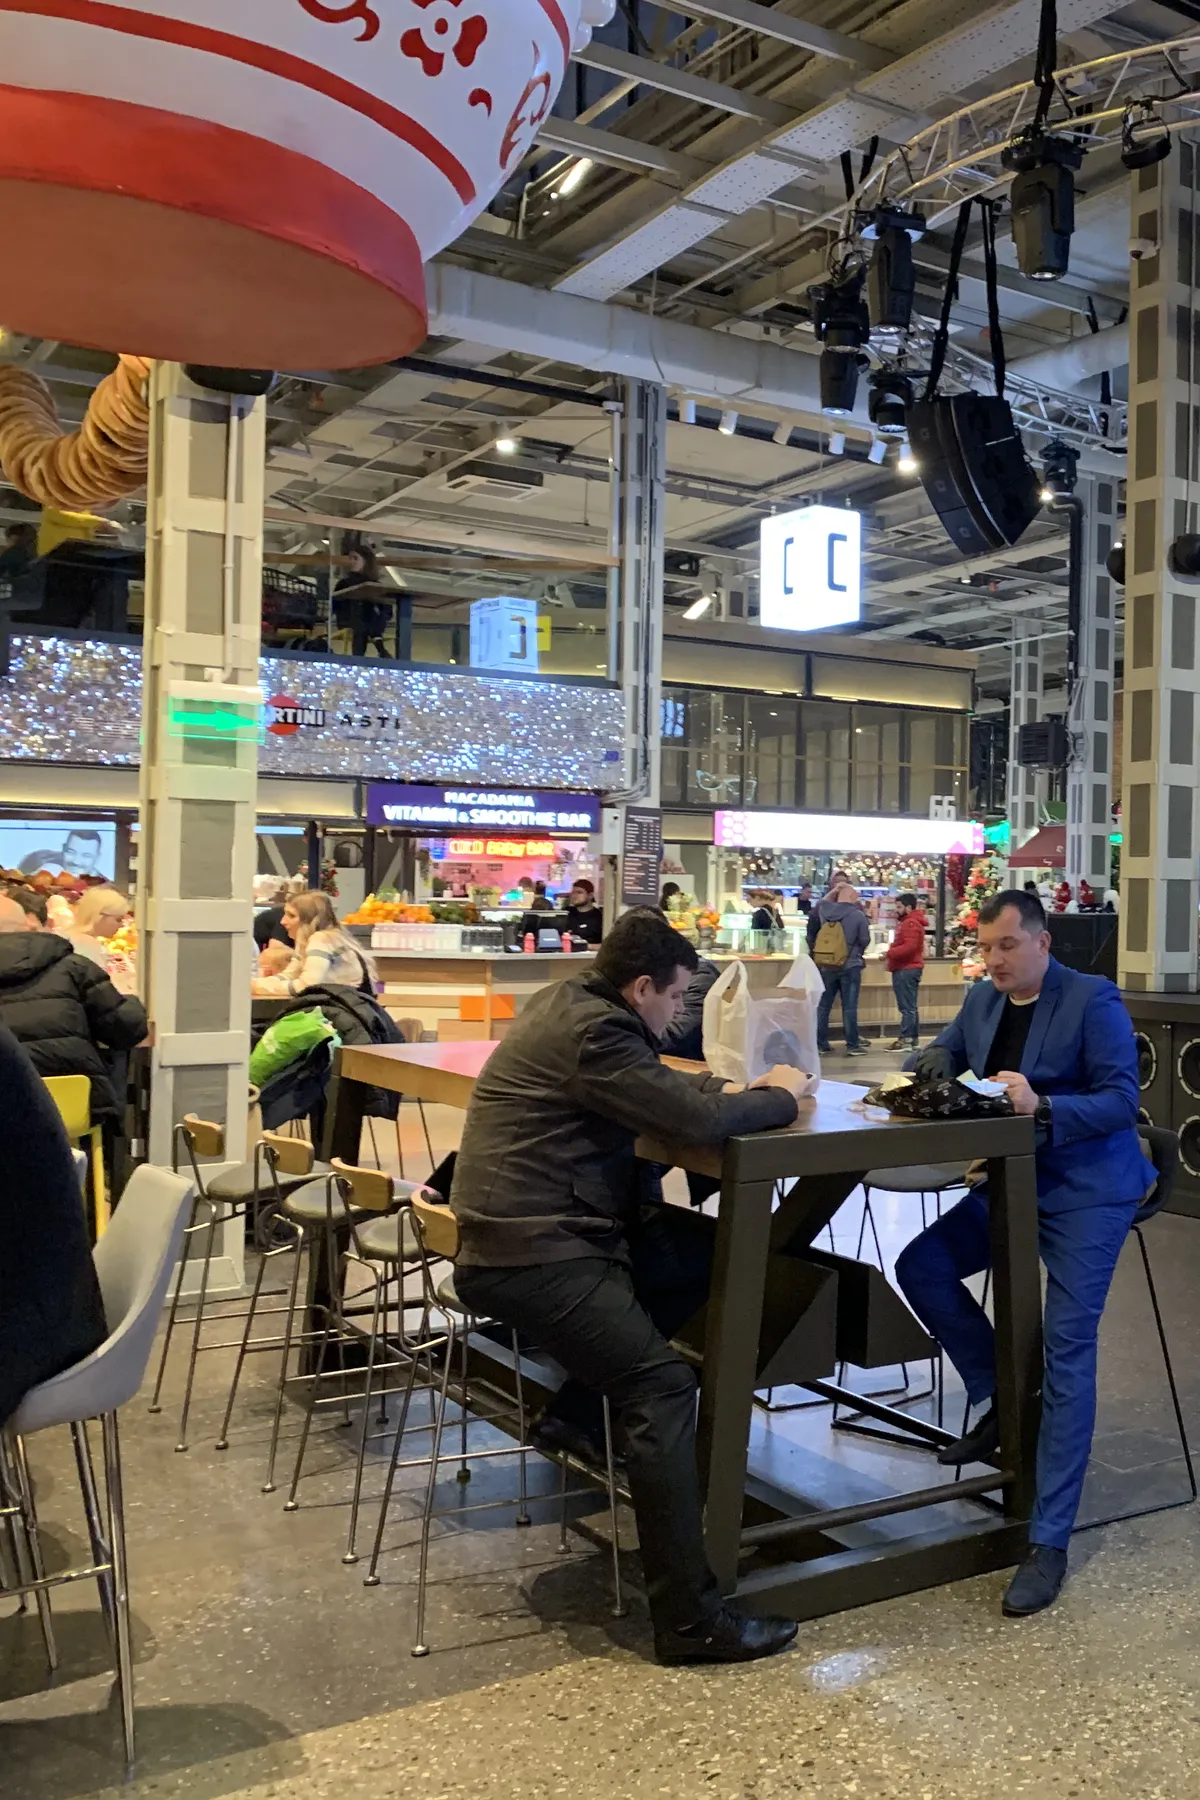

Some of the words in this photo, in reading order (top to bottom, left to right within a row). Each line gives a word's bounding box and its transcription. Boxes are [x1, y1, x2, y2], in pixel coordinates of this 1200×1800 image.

[827, 532, 848, 593] C
[339, 714, 400, 729] ASTI
[444, 791, 535, 807] MACADAMIA
[929, 794, 957, 821] 66
[382, 805, 458, 823] VITAMIN
[458, 811, 470, 824] &
[469, 809, 557, 827] SMOOTHIE
[557, 811, 592, 829] BAR
[526, 842, 554, 856] BAR
